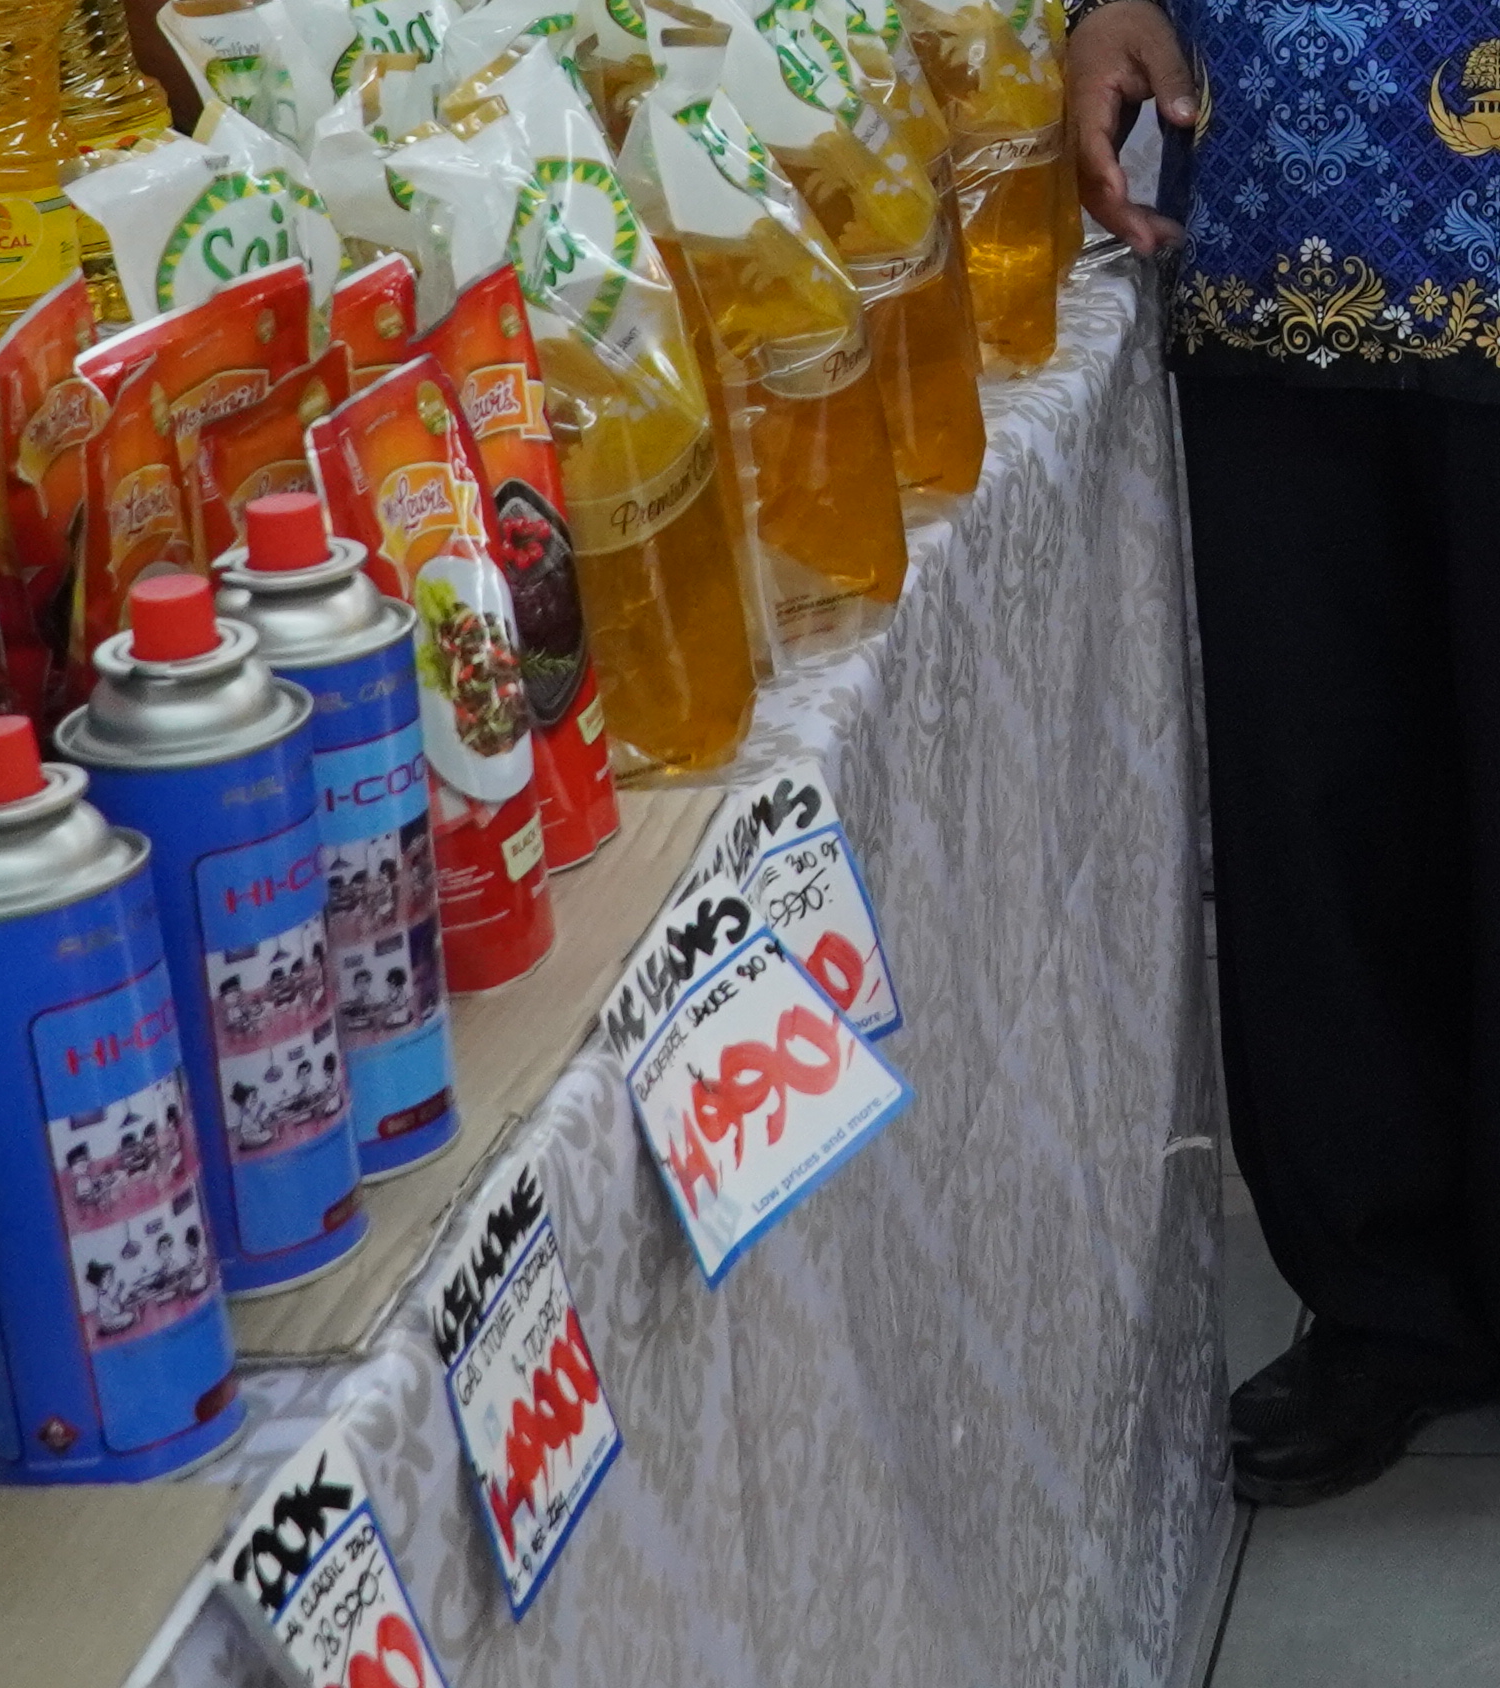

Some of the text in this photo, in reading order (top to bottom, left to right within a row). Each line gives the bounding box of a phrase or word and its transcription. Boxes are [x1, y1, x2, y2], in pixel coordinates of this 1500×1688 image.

[752, 1096, 884, 1215] Low prices and more
